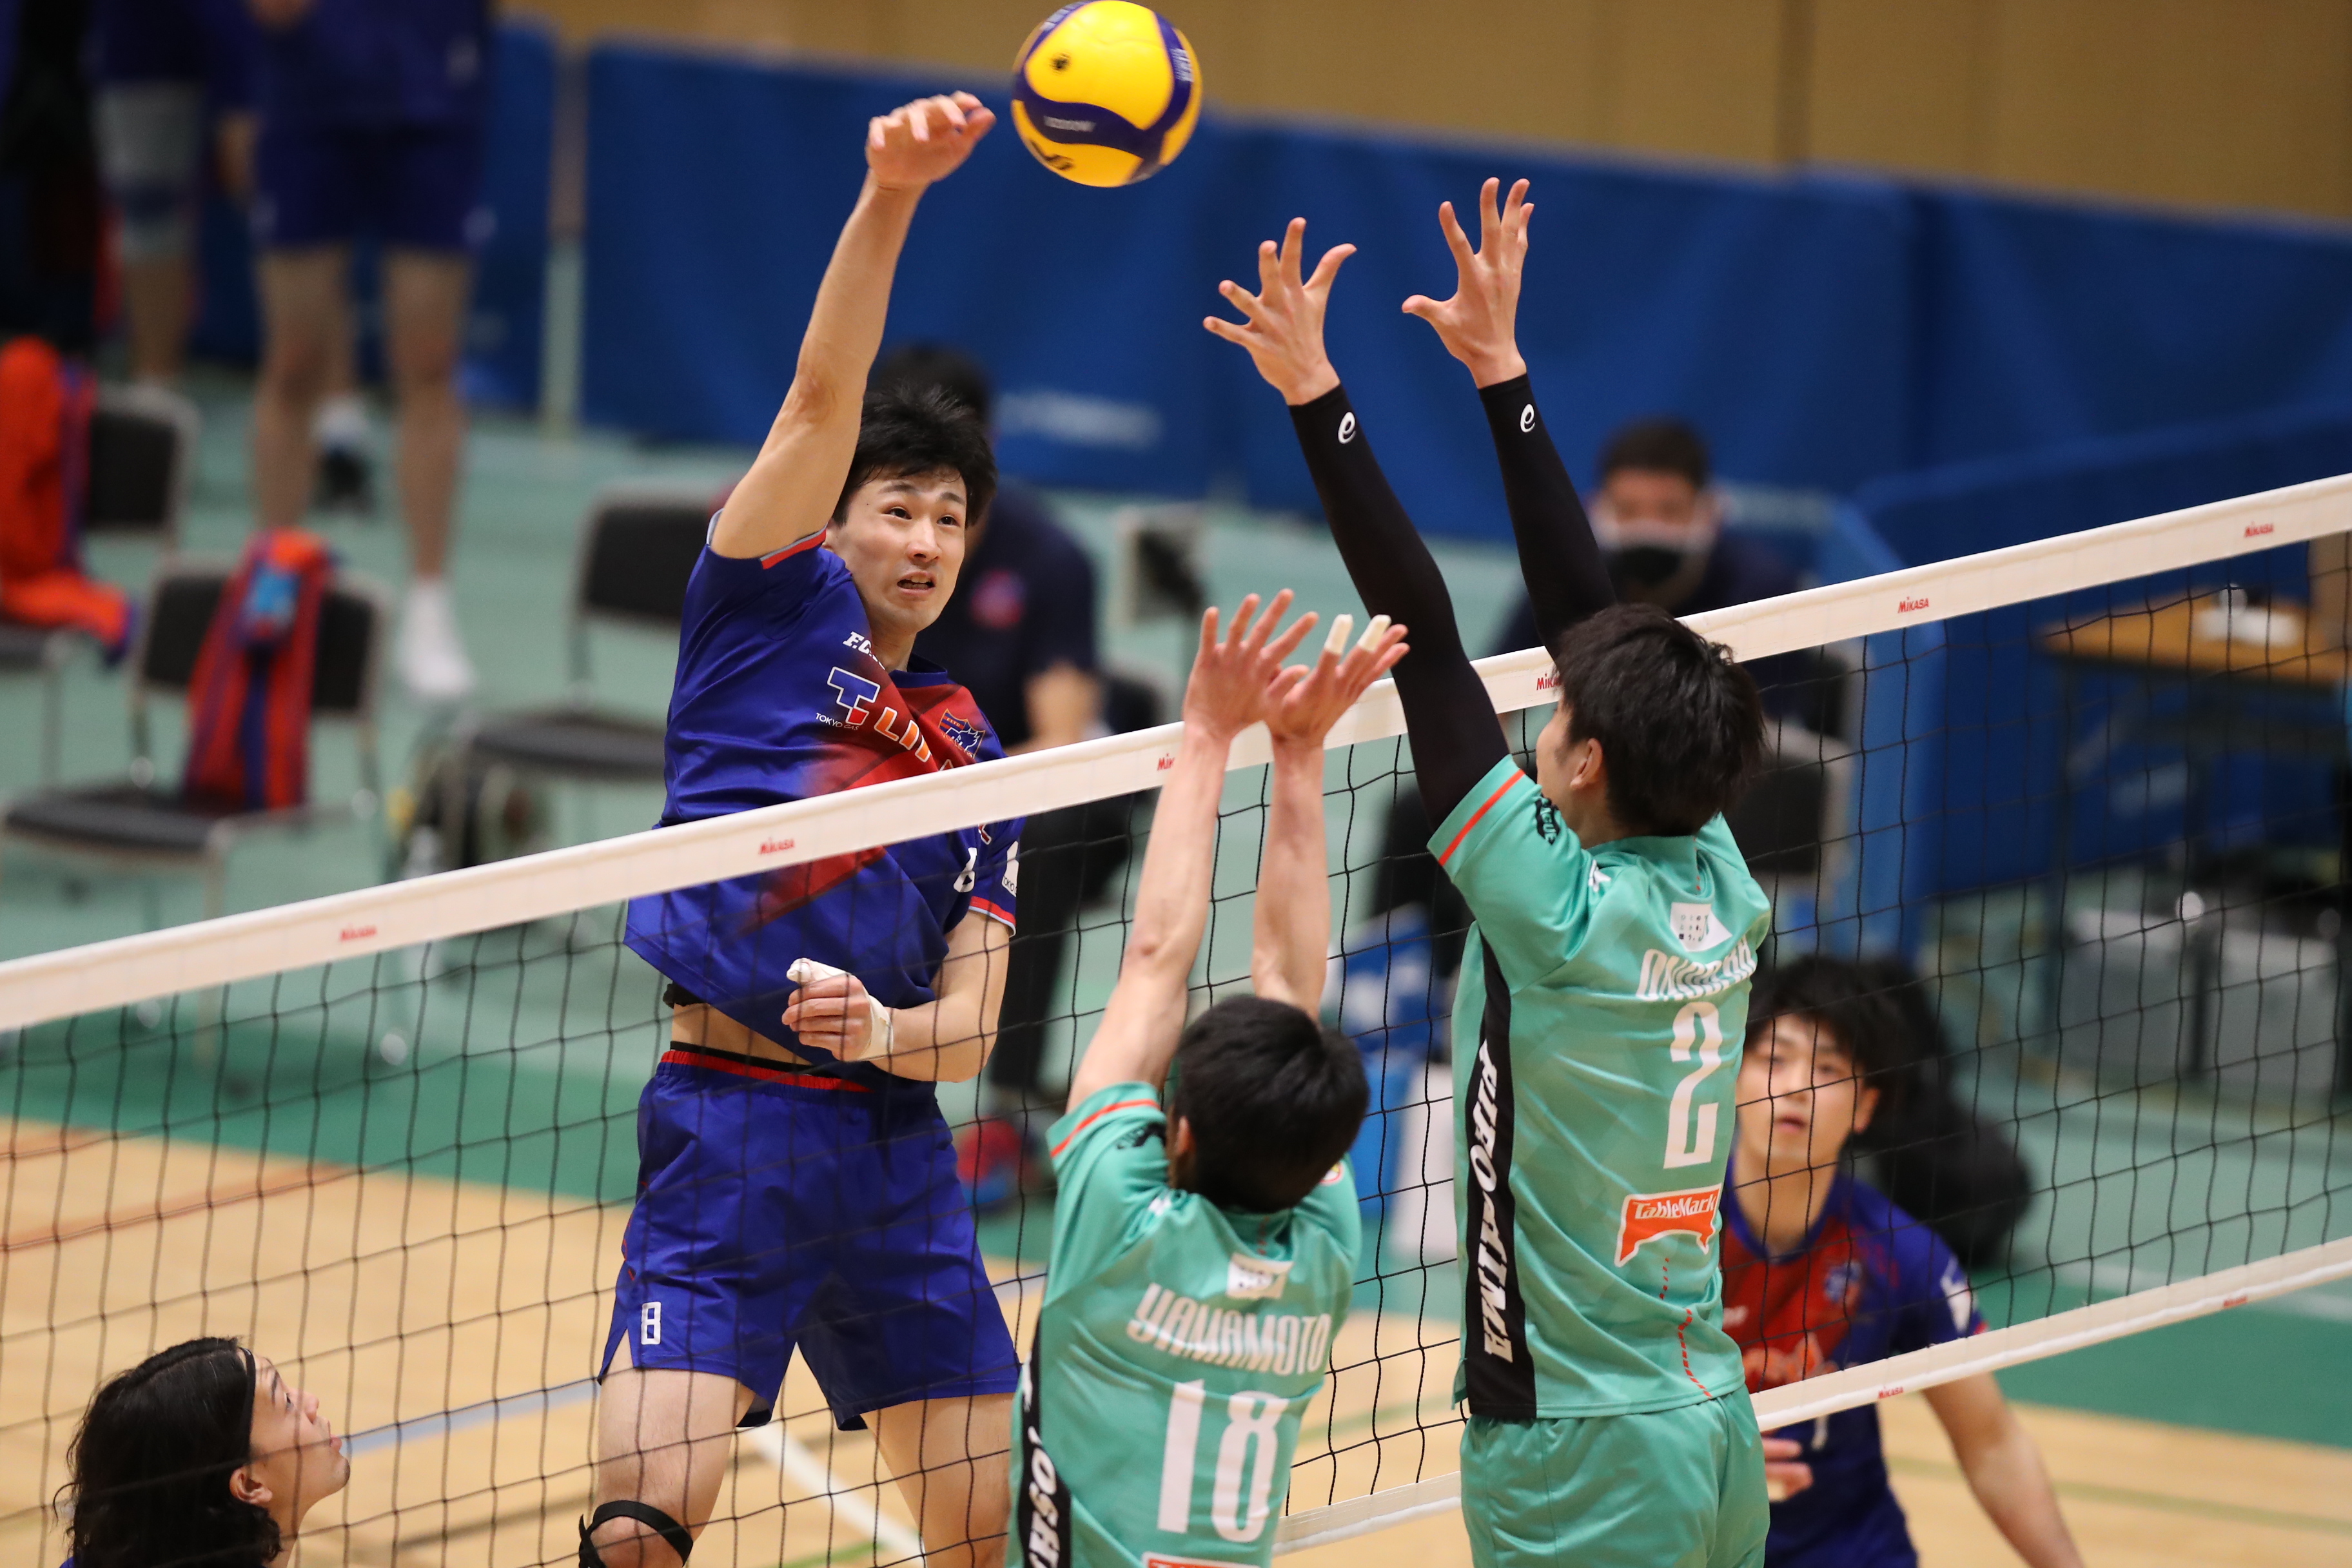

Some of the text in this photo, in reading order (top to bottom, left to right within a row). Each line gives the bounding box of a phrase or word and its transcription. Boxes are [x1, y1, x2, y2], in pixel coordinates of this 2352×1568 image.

[816, 712, 843, 728] TOKYO
[1663, 1001, 1723, 1170] 2
[641, 1301, 662, 1346] 8
[1126, 1282, 1333, 1376] YAMAMOTO
[1157, 1378, 1289, 1544] 18
